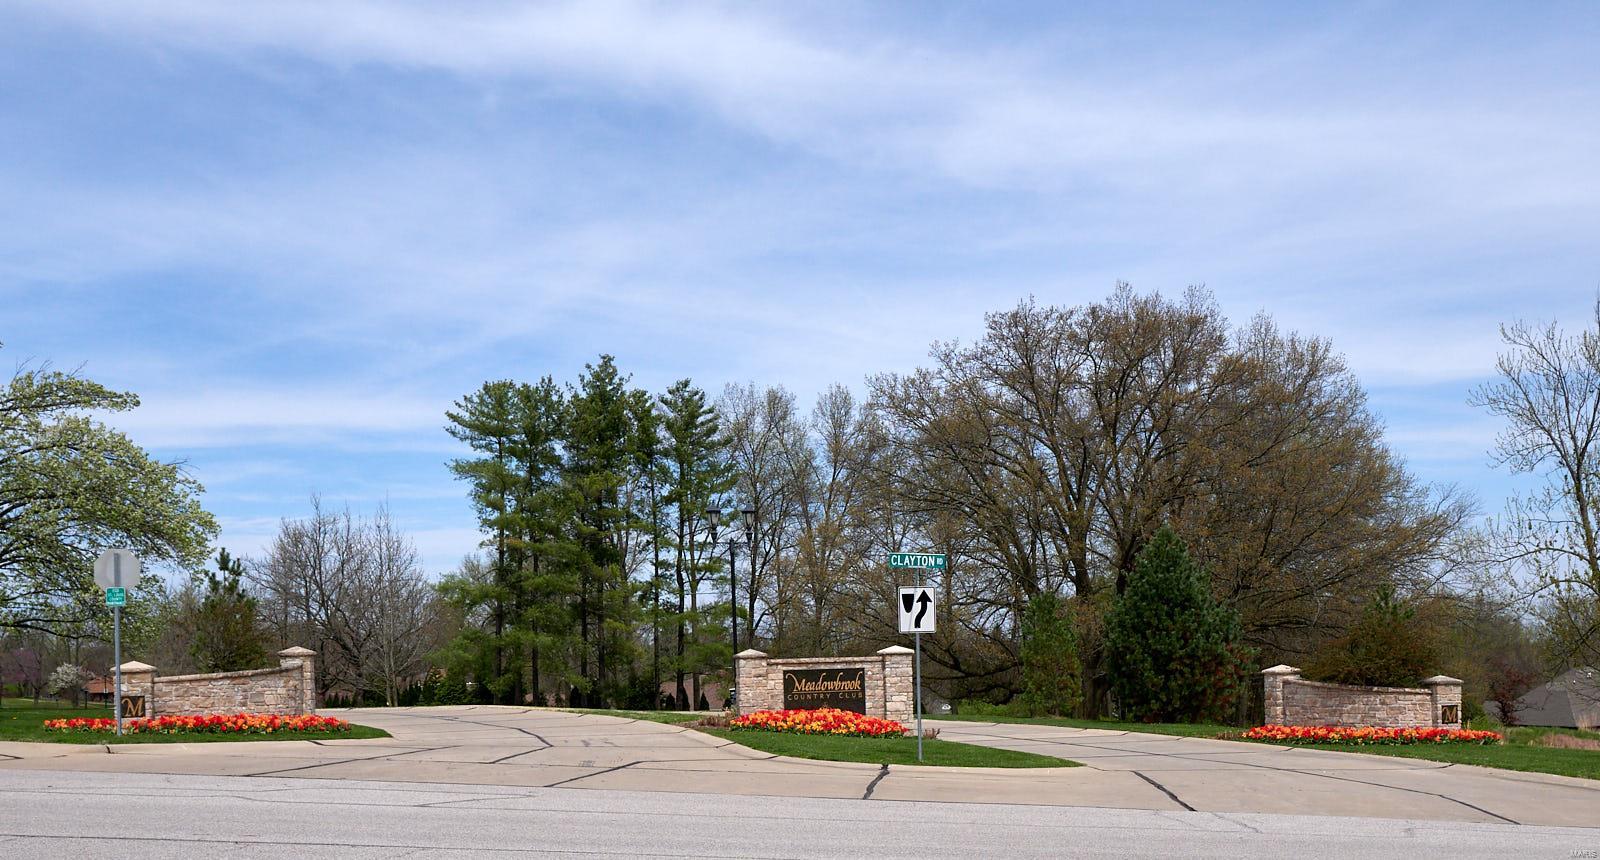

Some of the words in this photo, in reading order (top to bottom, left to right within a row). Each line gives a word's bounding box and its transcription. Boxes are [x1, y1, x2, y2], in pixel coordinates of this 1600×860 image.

[891, 555, 935, 566] CLAYTON
[936, 557, 944, 565] RD
[785, 671, 863, 692] Meadowbrook
[787, 692, 831, 701] COUNTRY
[121, 697, 144, 717] M
[1442, 706, 1457, 723] M
